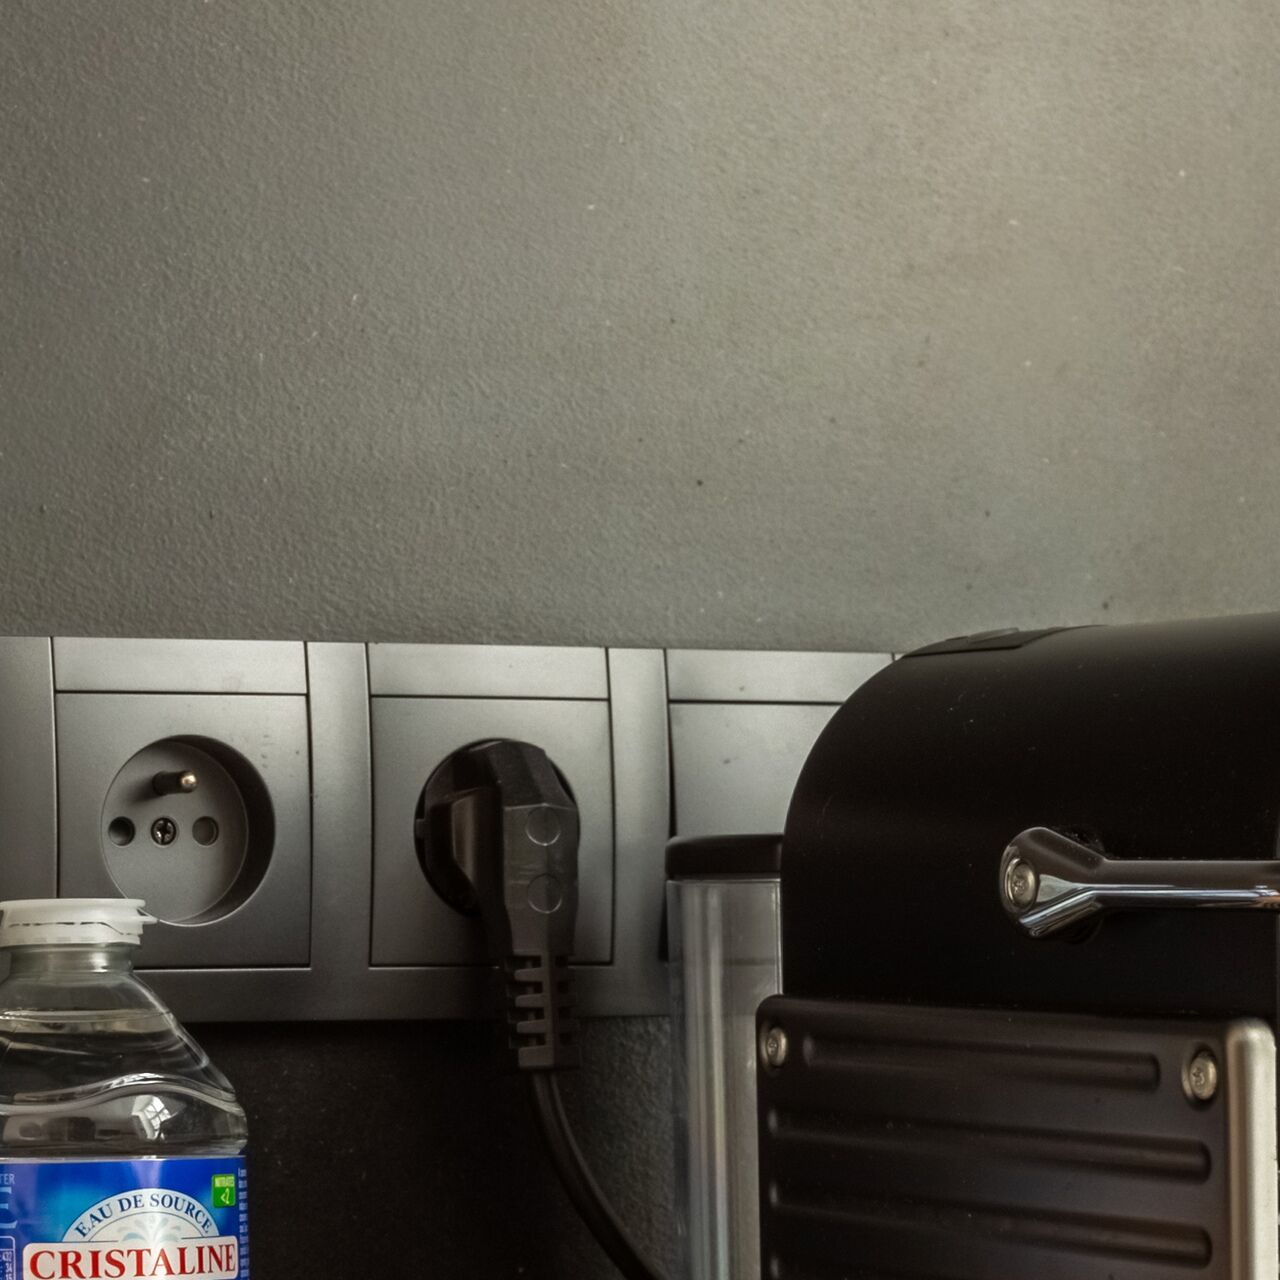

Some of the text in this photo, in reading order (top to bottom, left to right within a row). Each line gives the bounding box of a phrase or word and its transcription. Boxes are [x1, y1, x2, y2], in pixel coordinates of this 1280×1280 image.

[74, 1193, 213, 1238] EAU DE SOURCE
[28, 1243, 237, 1280] CRISTALINE
